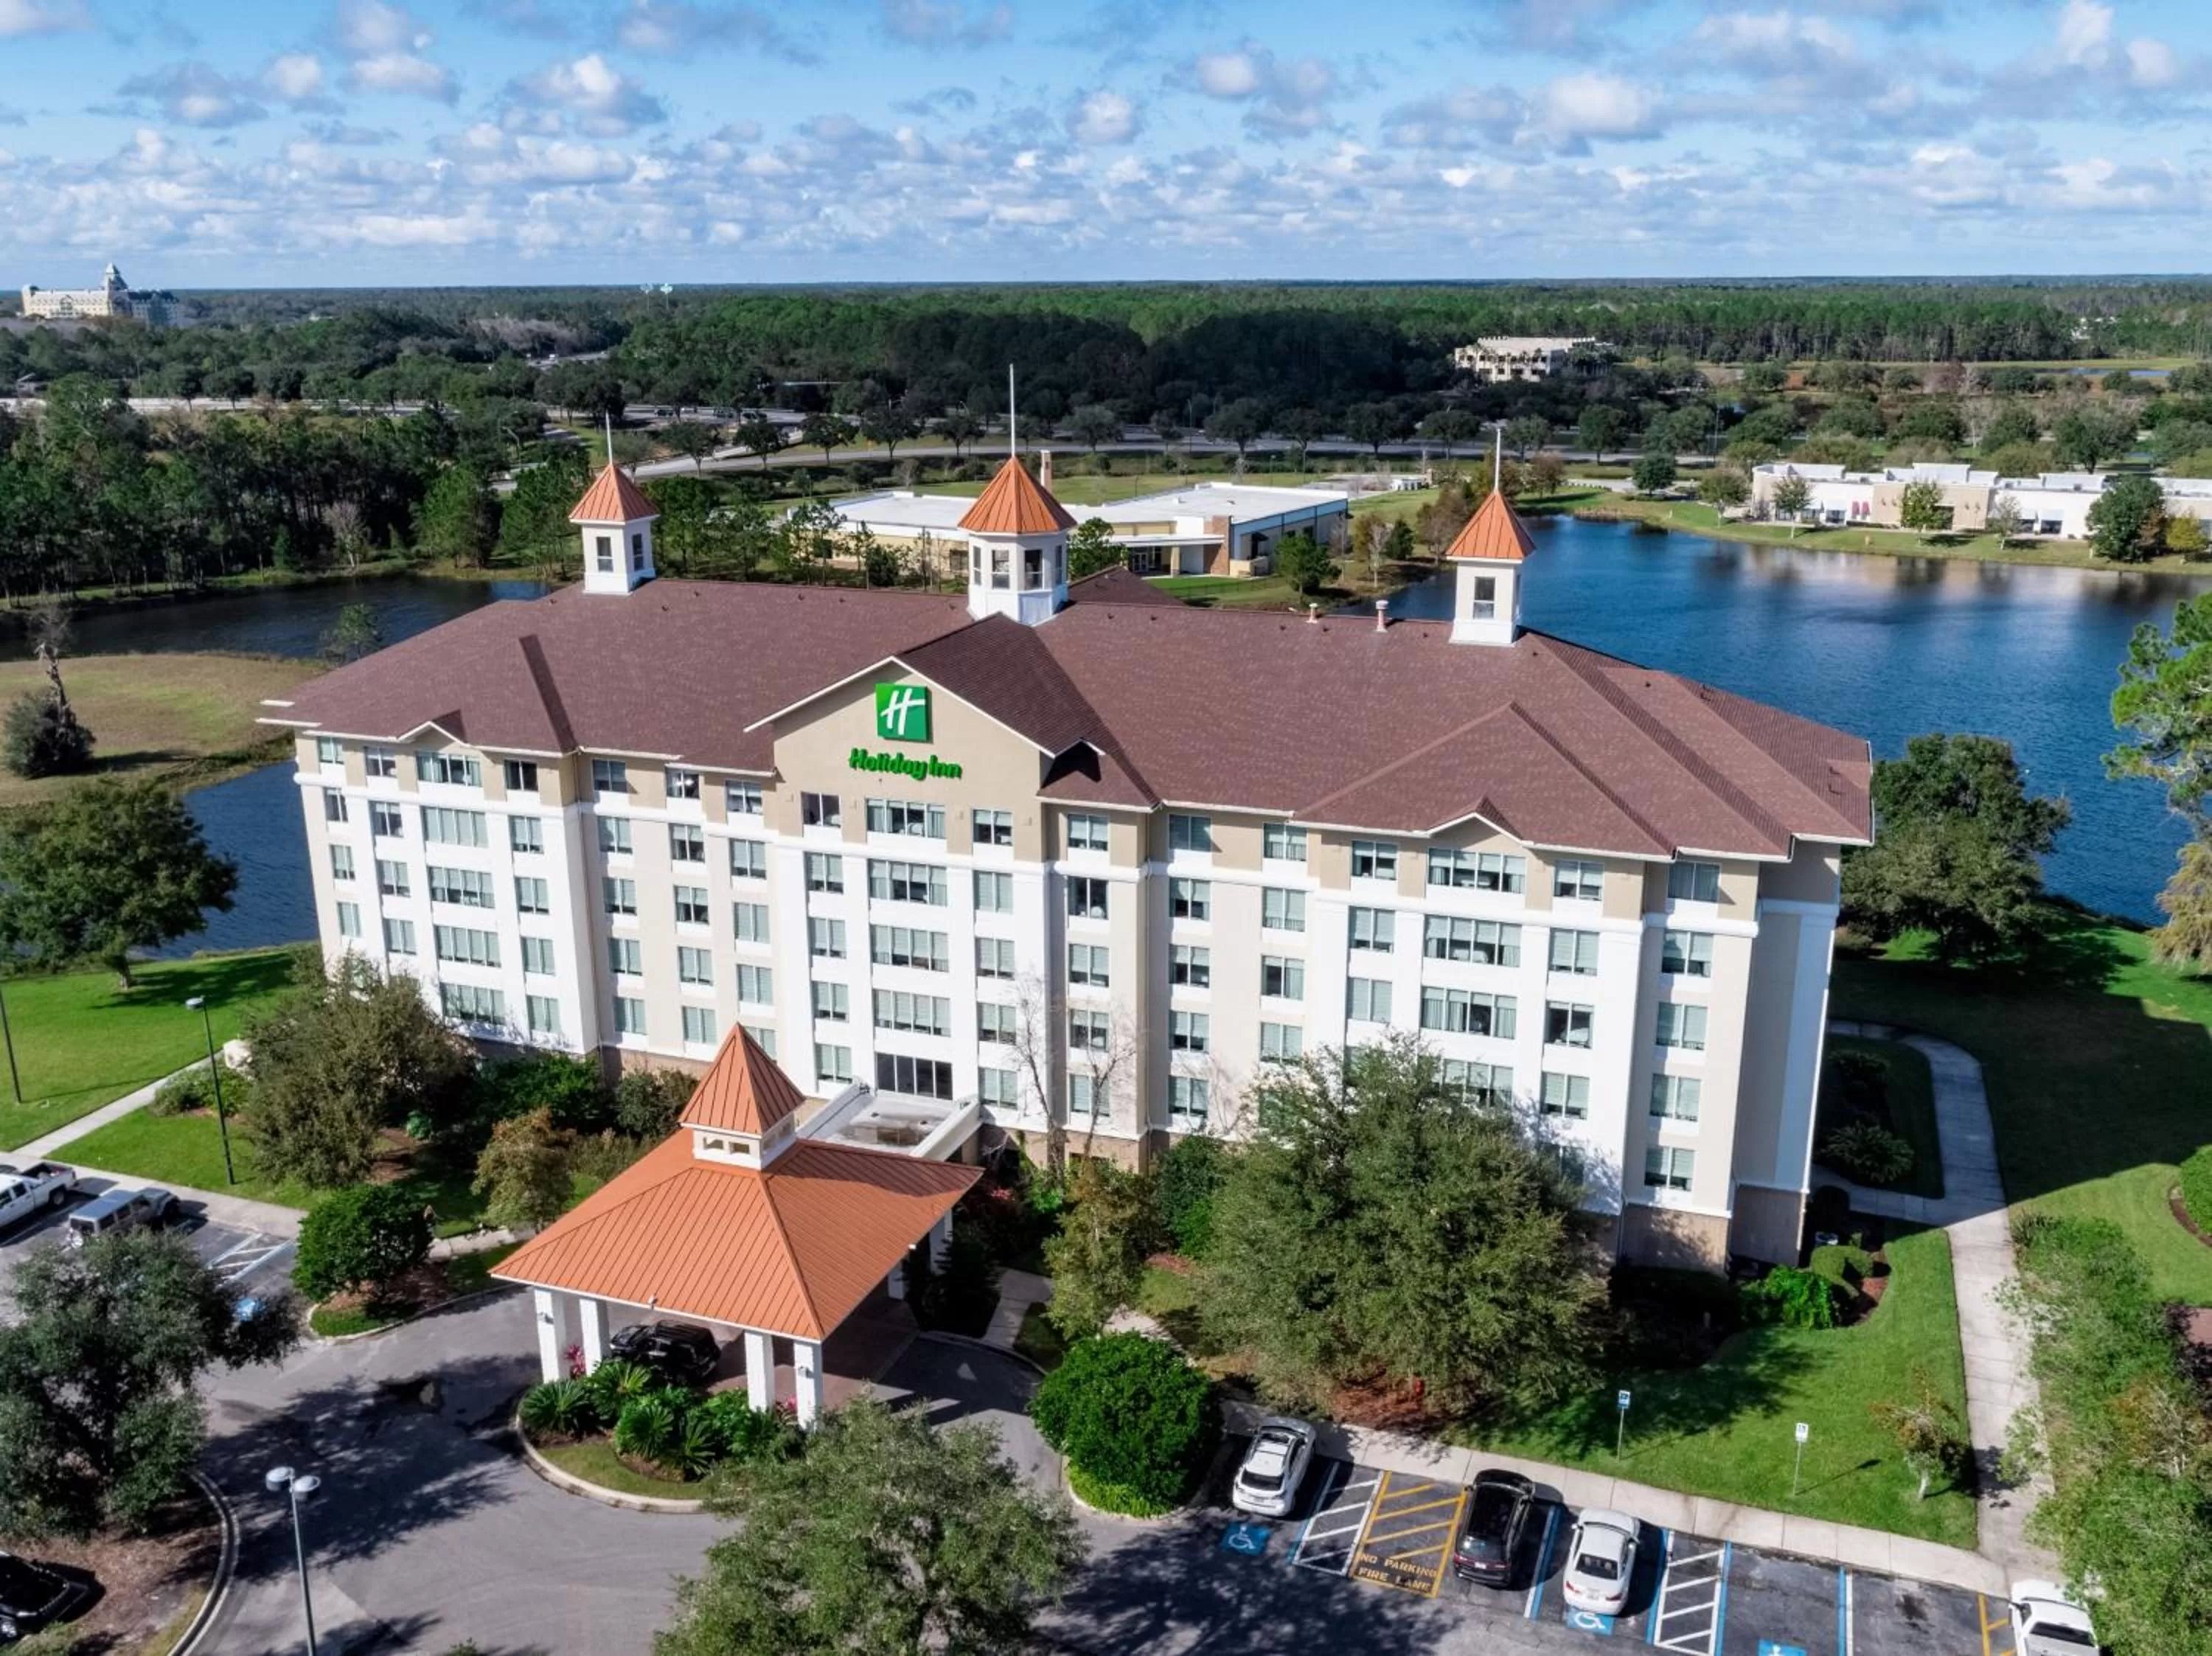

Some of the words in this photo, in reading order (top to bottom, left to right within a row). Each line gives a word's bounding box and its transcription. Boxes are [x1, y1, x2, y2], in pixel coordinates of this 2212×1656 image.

[849, 748, 928, 782] Holiday
[929, 754, 962, 779] Inn
[1360, 1554, 1377, 1564] NO
[1384, 1558, 1438, 1577] PARKING
[1359, 1567, 1390, 1582] FIRE
[1395, 1575, 1430, 1591] LANE
